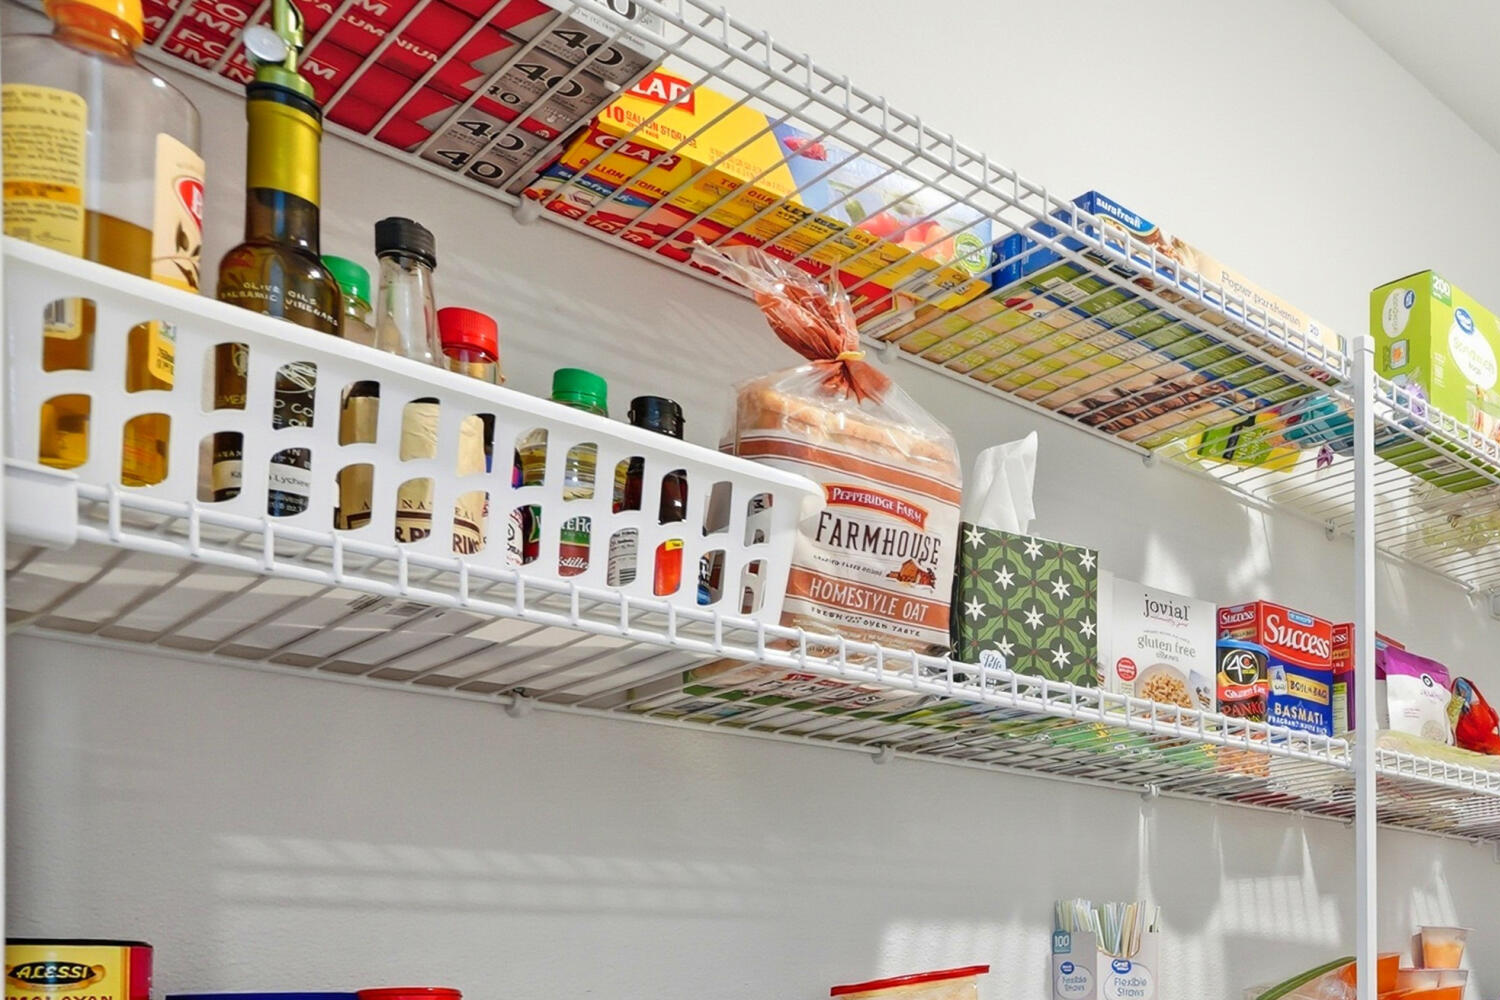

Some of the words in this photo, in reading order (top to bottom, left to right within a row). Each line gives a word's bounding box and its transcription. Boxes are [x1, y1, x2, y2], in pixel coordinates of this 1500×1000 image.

[552, 27, 623, 66] 40
[513, 61, 583, 97] 40
[630, 77, 692, 104] LAD
[457, 118, 524, 151] 40
[436, 149, 504, 178] 40
[832, 487, 895, 511] PEPPERIDGE
[896, 503, 922, 522] FARM
[815, 511, 941, 568] FARMHOUSE
[809, 577, 897, 616] HOMESTYLE
[902, 603, 930, 622] OAT
[1143, 593, 1190, 621] jovial
[1137, 635, 1173, 652] gluten
[1174, 640, 1197, 658] free
[1263, 614, 1331, 659] Success
[1226, 654, 1254, 683] 4C
[1274, 702, 1324, 726] BASMATI
[1055, 935, 1070, 947] 100
[16, 965, 89, 979] ALESSI
